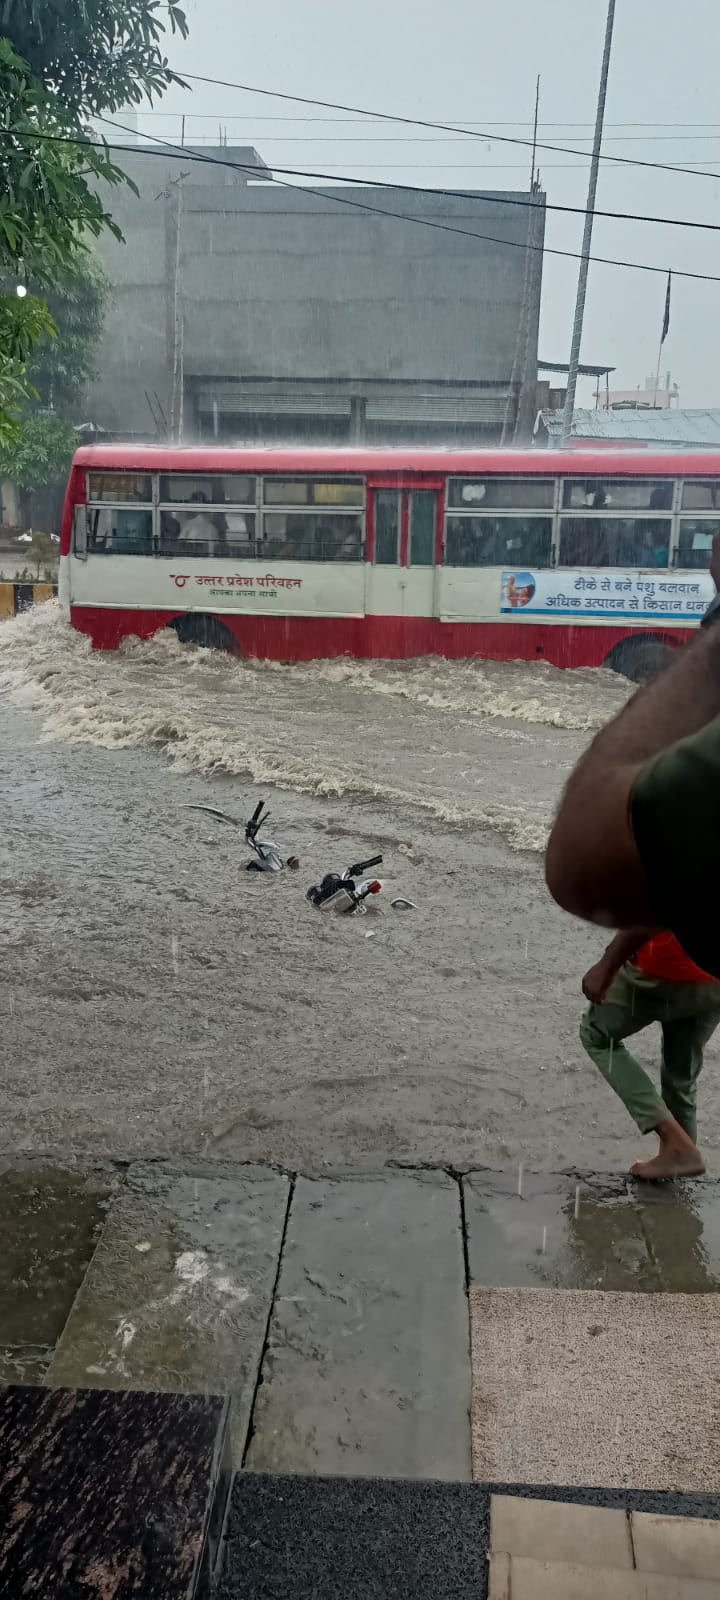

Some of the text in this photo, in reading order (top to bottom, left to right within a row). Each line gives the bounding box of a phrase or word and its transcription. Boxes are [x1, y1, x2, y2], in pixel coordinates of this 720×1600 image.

[195, 574, 303, 589] उत्तर प्रदेश परिवहन
[574, 576, 700, 597] टीके से बने पशु बलवान
[545, 593, 582, 607] अधिक
[584, 598, 626, 609] उत्पादन
[628, 595, 639, 610] से
[643, 596, 683, 611] किसान
